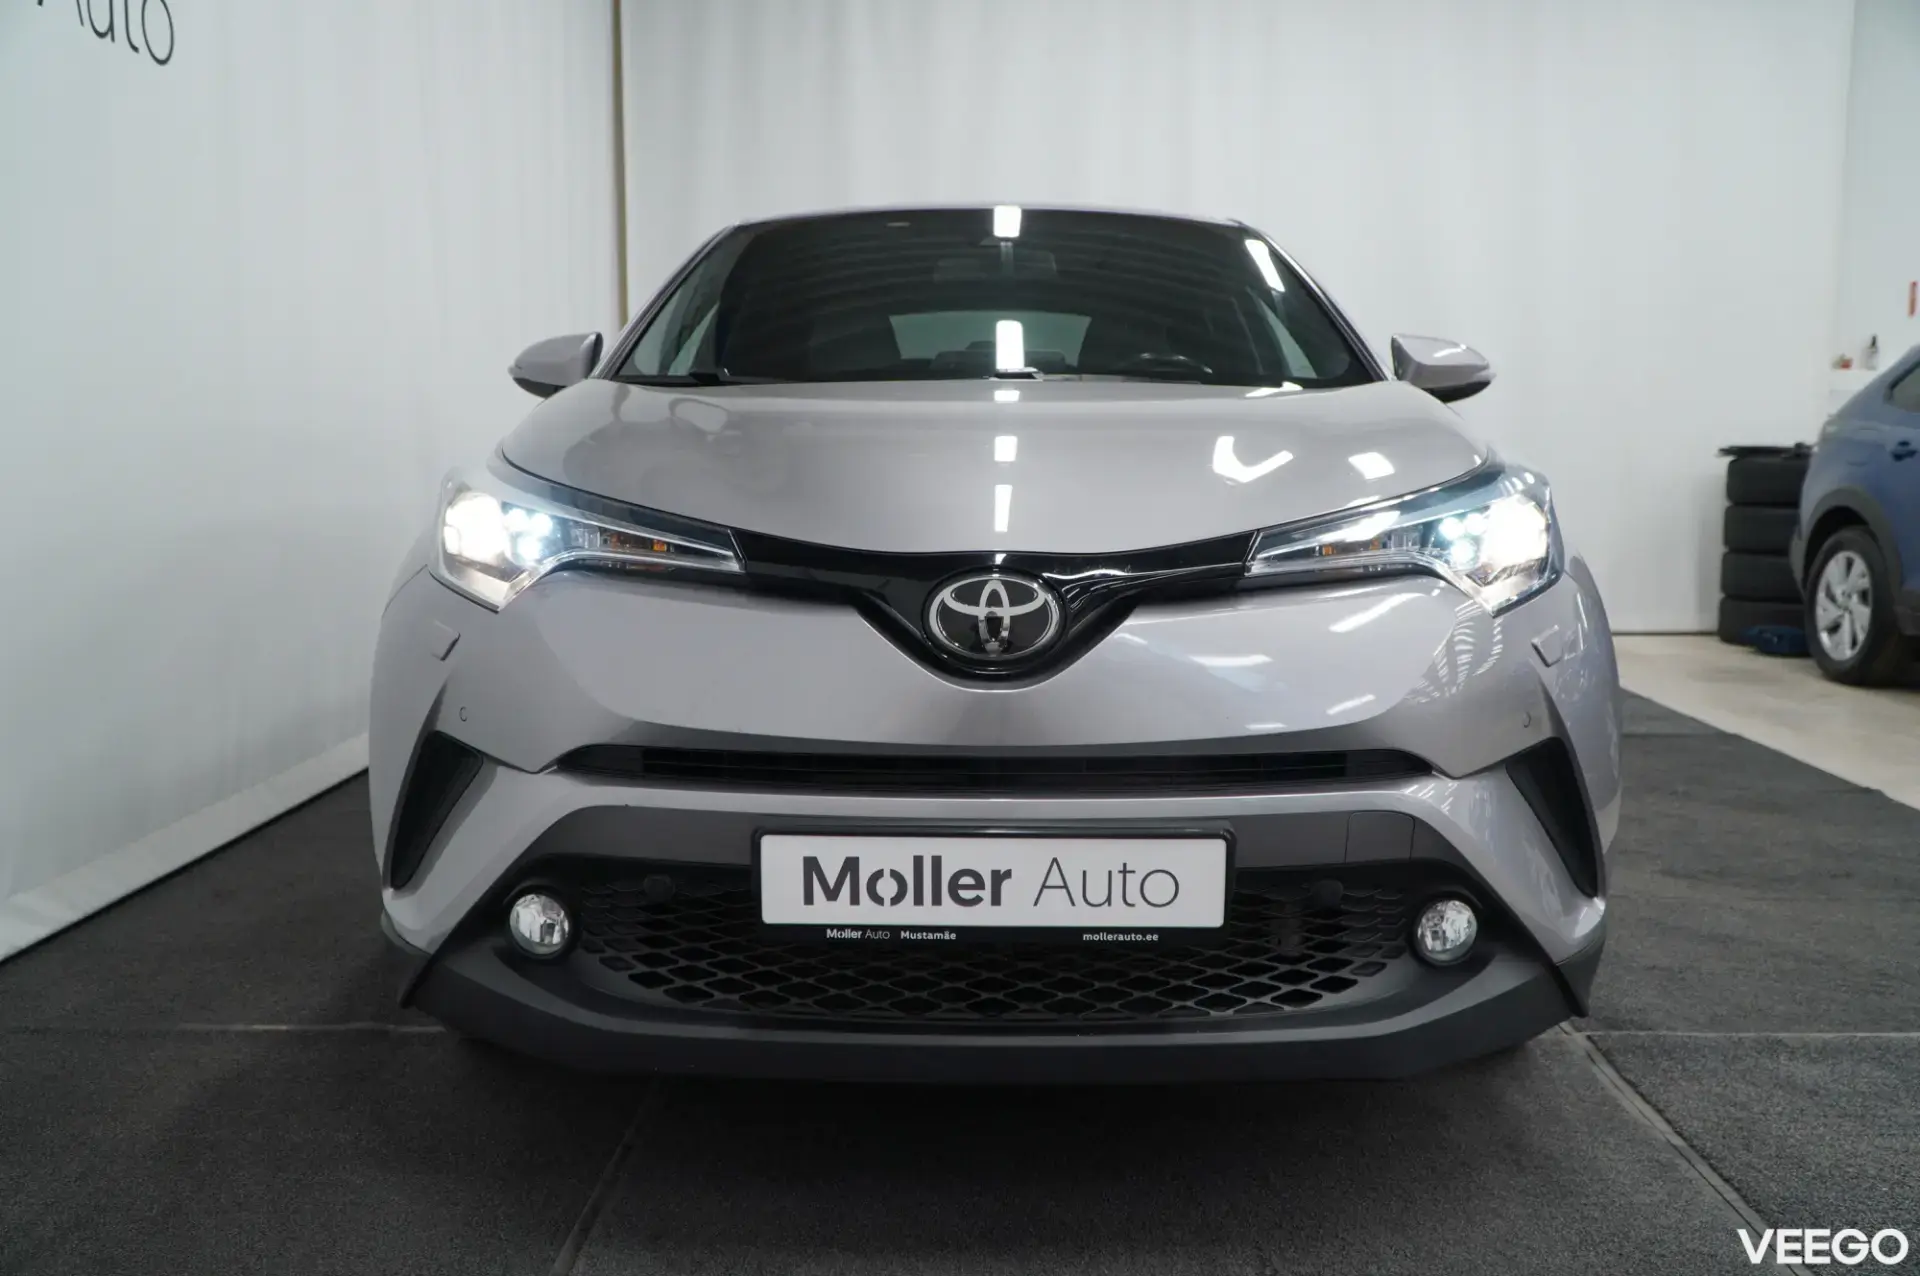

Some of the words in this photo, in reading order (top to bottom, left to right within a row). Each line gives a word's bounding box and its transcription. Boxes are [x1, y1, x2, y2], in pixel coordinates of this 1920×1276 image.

[76, 0, 174, 65] uto
[1033, 857, 1179, 907] Auto
[864, 929, 891, 940] Auto
[1082, 932, 1159, 941] mollerauto.ee
